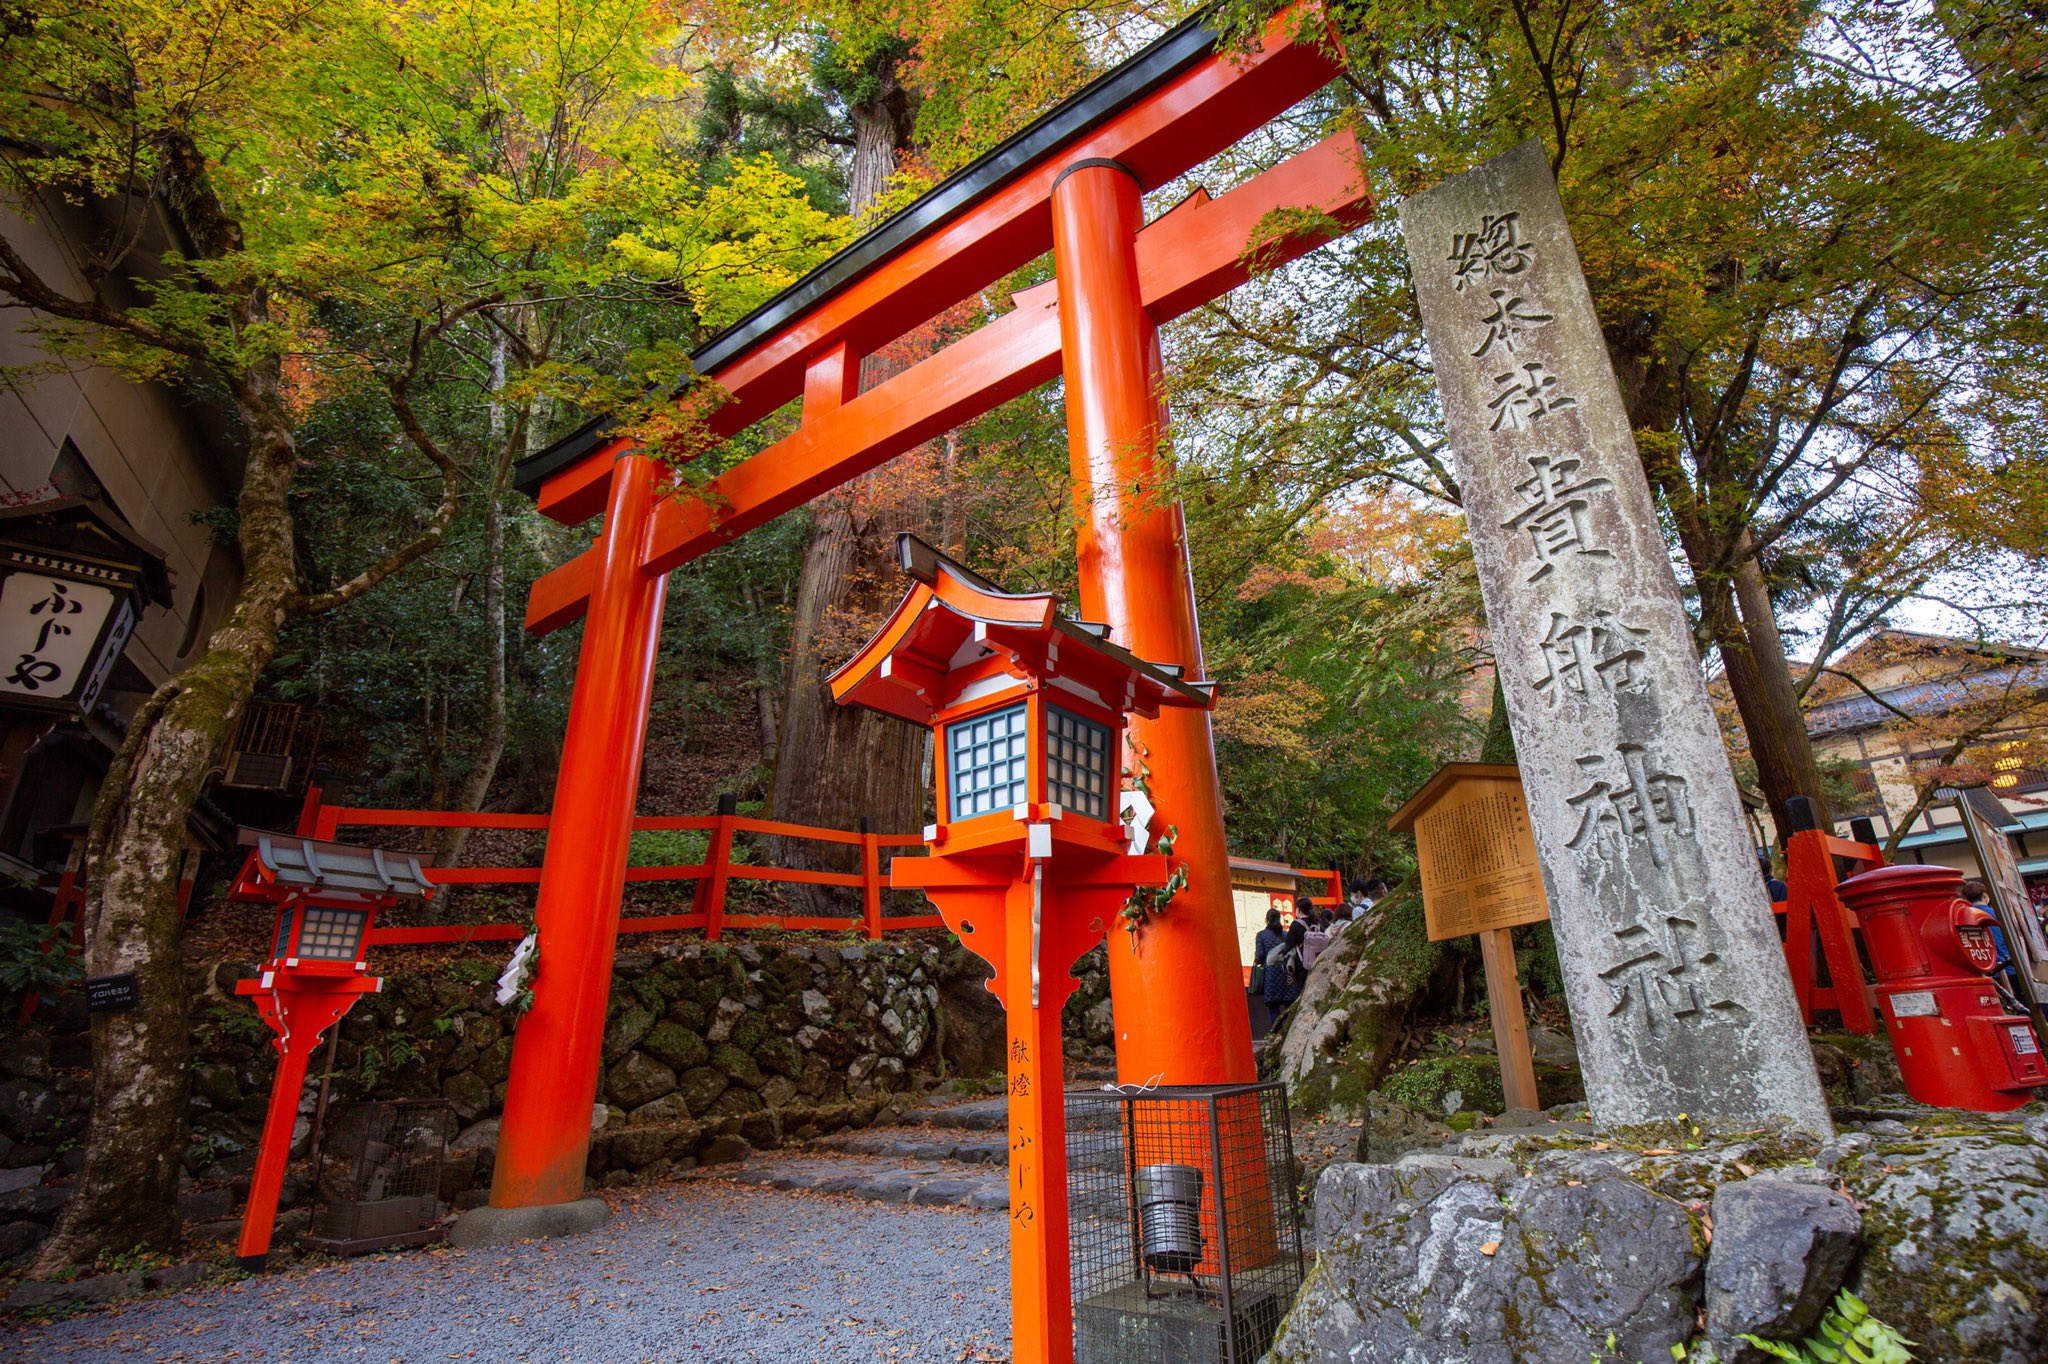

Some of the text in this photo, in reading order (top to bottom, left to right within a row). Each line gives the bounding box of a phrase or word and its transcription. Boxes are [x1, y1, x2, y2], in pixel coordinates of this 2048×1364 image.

[4, 580, 83, 691] ふじや
[1970, 948, 1993, 961] POST
[91, 985, 130, 999] イロハモミジ
[1010, 1036, 1035, 1230] 献燈 ふじや
